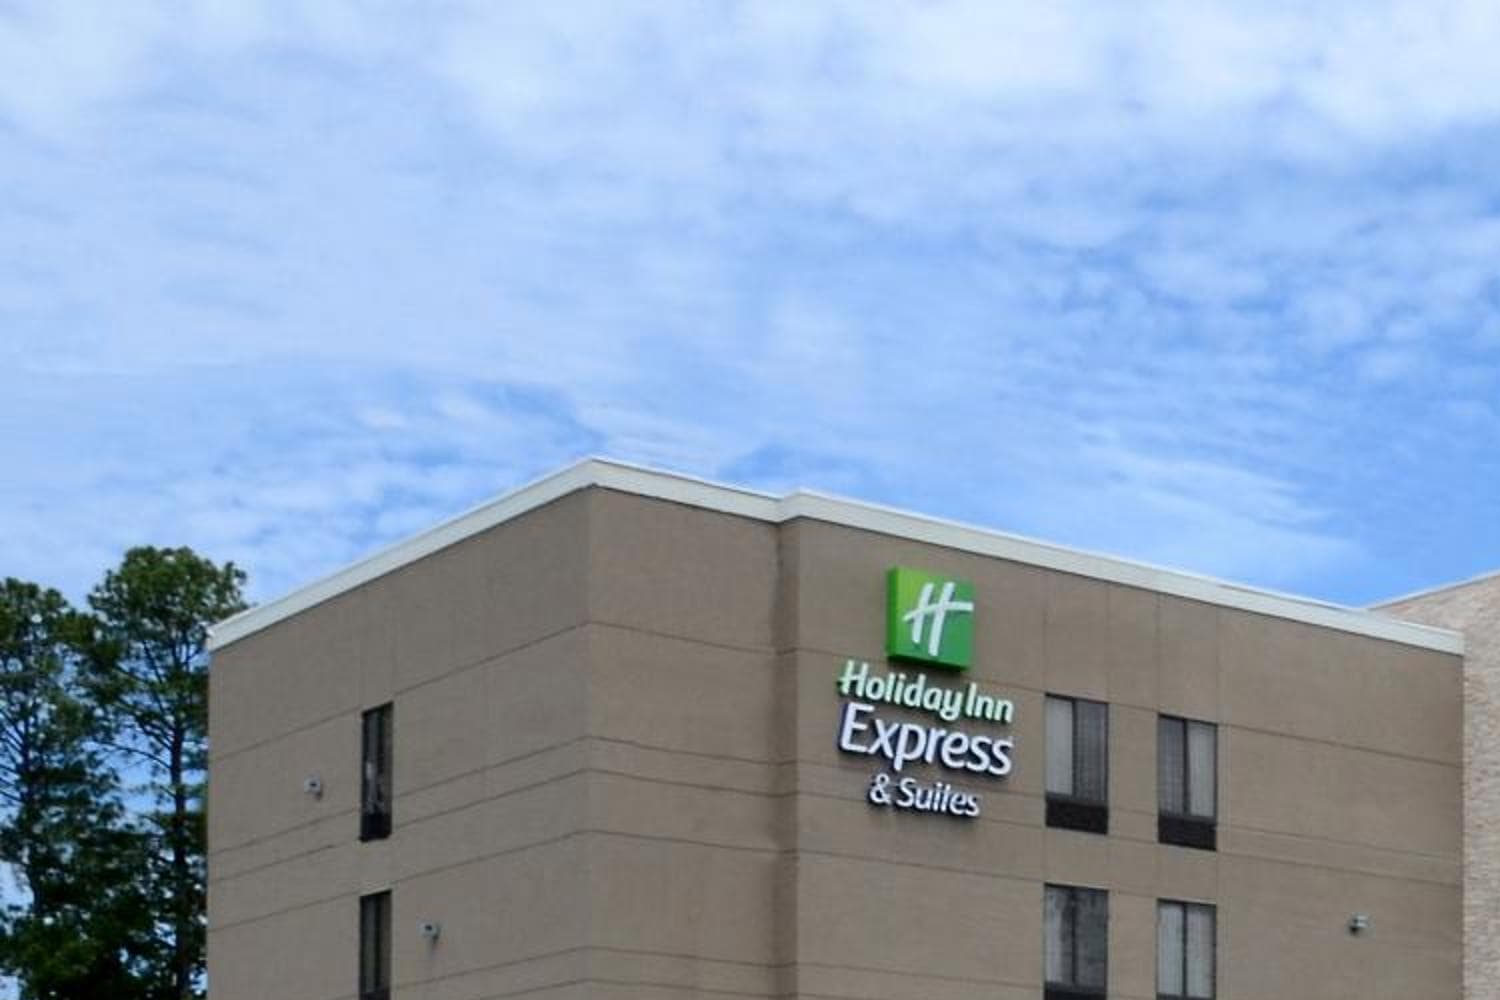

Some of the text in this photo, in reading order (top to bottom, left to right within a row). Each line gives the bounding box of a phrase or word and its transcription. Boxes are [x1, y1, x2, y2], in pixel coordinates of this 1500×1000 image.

[838, 660, 1014, 723] Holiday Inn
[841, 702, 1014, 775] Express
[869, 773, 980, 817] & Suites
